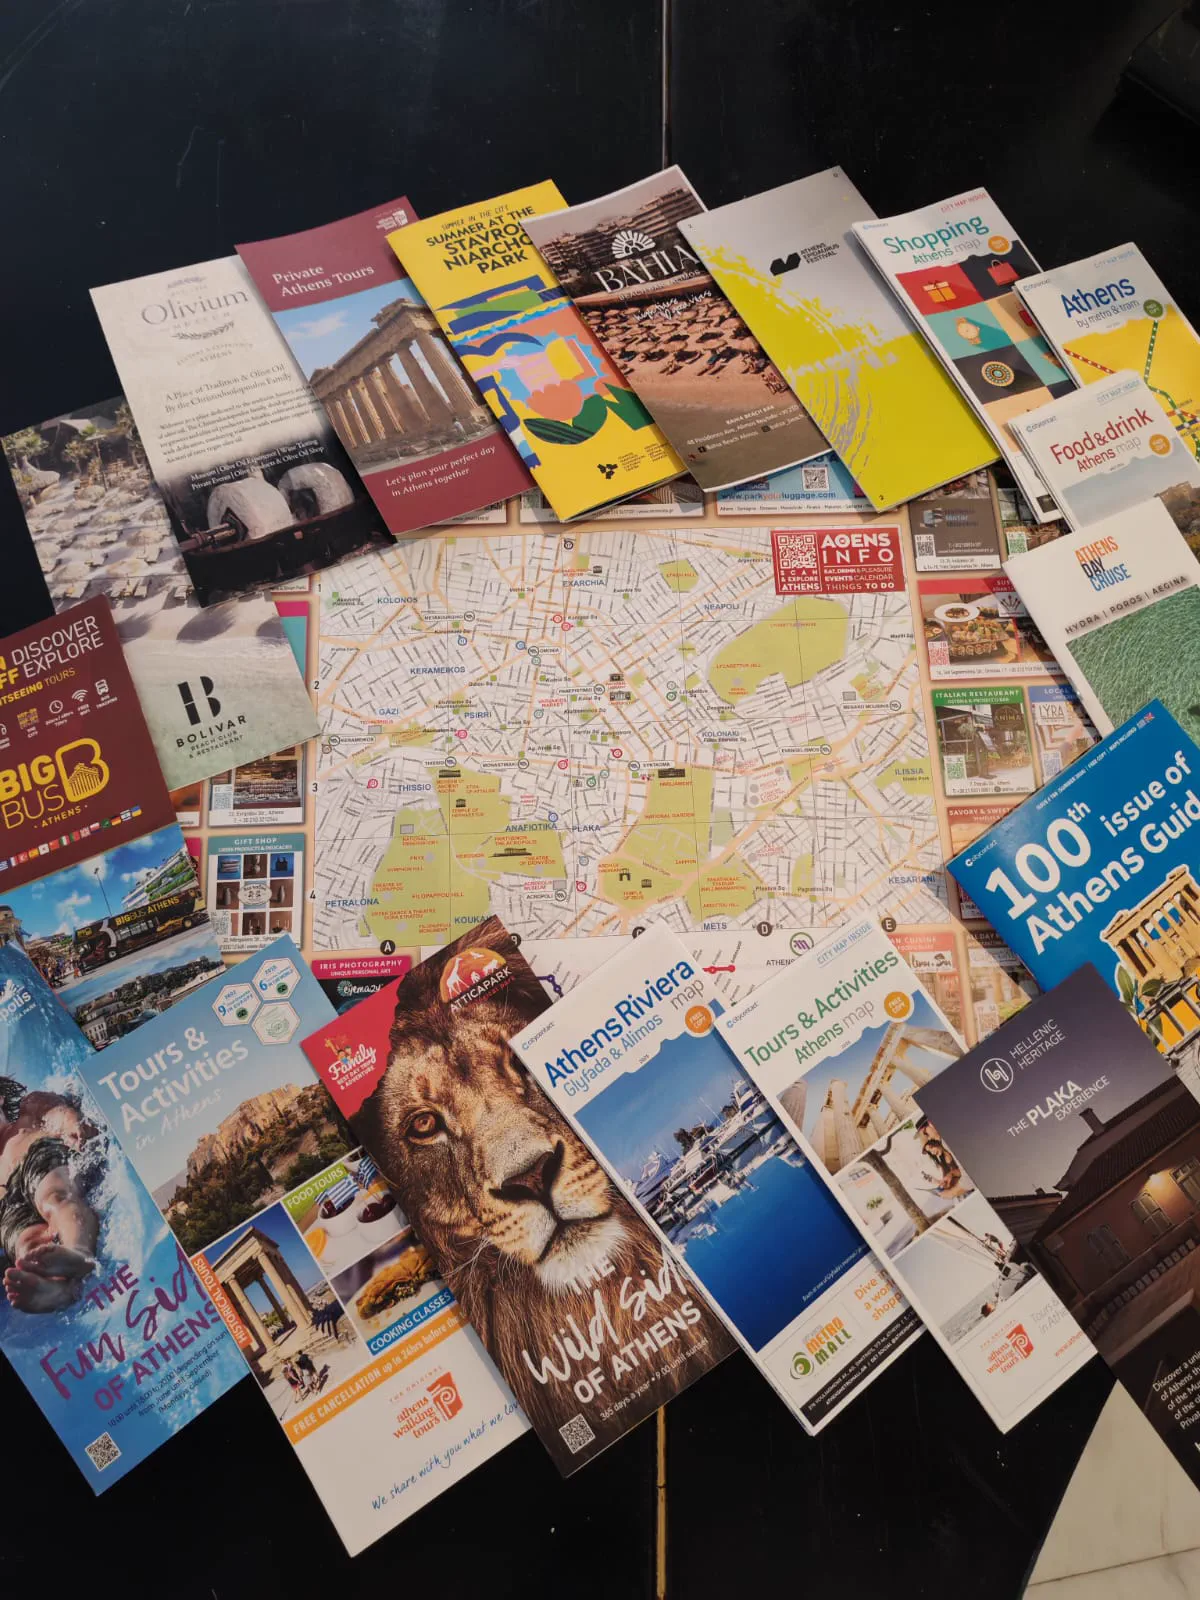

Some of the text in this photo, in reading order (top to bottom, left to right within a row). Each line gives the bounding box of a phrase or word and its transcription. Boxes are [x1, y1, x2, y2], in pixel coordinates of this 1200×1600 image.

[426, 205, 536, 247] SUMMER AT THE
[883, 215, 989, 255] Shopping
[443, 233, 533, 271] NIARCHO
[477, 249, 529, 274] PARK
[912, 238, 983, 265] Athens map
[272, 265, 325, 285] Private
[281, 265, 375, 297] Athens Tours
[594, 244, 701, 294] BAHIA
[141, 290, 249, 326] Olivium
[1060, 278, 1136, 319] Athens
[1075, 299, 1142, 330] by metro tram
[385, 445, 496, 488] Let's plan your perfect day
[1076, 436, 1142, 473] Athens map
[392, 467, 470, 498] in Athens together
[822, 549, 894, 565] INFO
[1074, 535, 1119, 564] ATHENS
[562, 580, 605, 588] EXARCHIA
[788, 575, 819, 583] EXPLORE
[824, 573, 894, 583] EVENTS CALENDAR
[1081, 557, 1106, 579] DAY
[1089, 563, 1131, 592] CRUISE
[377, 596, 418, 604] KOLONOS
[782, 581, 895, 591] ATHENS THINGS TO DO
[704, 603, 740, 611] NEAPOLI
[1064, 575, 1188, 635] HYDRA POROS AEGINA
[11, 615, 99, 666] DISCOVER
[23, 630, 104, 679] EXPLORE
[44, 666, 77, 687] TOURS
[314, 680, 320, 690] 2
[410, 666, 466, 675] KERAMEIKOS
[935, 689, 1020, 698] ITALIAN RESTAURANT
[378, 707, 399, 716] GAZI
[1039, 703, 1064, 717] LYRA
[176, 714, 247, 748] BOLIVAR
[197, 734, 243, 756] RESTAURANT
[218, 730, 238, 741] CLUB
[0, 754, 56, 802] BIG
[312, 782, 318, 793] 3
[1099, 779, 1167, 838] issue
[1165, 750, 1192, 786] of
[1, 783, 65, 829] BUS
[42, 805, 82, 828] ATHENS
[234, 836, 278, 845] GIFT SHOP
[888, 875, 936, 885] KESARIANI
[1026, 846, 1146, 956] Athens
[1139, 789, 1200, 854] Guid
[115, 896, 180, 927] BIG ATHENS
[325, 898, 380, 908] PETRALONA
[704, 923, 727, 931] METS
[384, 941, 391, 952] A
[816, 922, 873, 965] CITY MAP INSIDE
[339, 959, 404, 969] PHOTOGRAPHY
[449, 966, 514, 1013] ATTICAPARK
[670, 978, 705, 1010] map
[743, 950, 900, 1067] Tours & Activities
[793, 1000, 875, 1065] Athens map
[1009, 1019, 1058, 1059] HELLENIC
[97, 1026, 209, 1100] Tours &
[327, 1043, 378, 1082] Family
[563, 1013, 664, 1097] Glyfada & Alimos
[1017, 1029, 1066, 1070] HERITAGE
[120, 1039, 249, 1134] Activities
[1054, 1075, 1111, 1122] EXPERIENCE
[160, 1087, 224, 1137] Athens
[1006, 1079, 1083, 1138] THE PLAKA
[286, 1166, 344, 1210] FOOD TOURS
[85, 1264, 140, 1312] THE
[564, 1258, 617, 1296] THE
[854, 1278, 878, 1300] Dive
[193, 1256, 248, 1344] HISTORICAL TOURS
[863, 1301, 873, 1310] a
[370, 1290, 452, 1352] COOKING CLASSES
[521, 1288, 620, 1385] Wild
[805, 1316, 845, 1355] METRO
[93, 1303, 222, 1412] OF ATHENS
[573, 1299, 702, 1404] OF ATHENS
[813, 1328, 852, 1366] MALL
[986, 1349, 1016, 1375] walking
[987, 1341, 1010, 1363] athens
[39, 1331, 126, 1400] Fun
[292, 1324, 448, 1435] FREE CANCELLATION up before
[599, 1337, 709, 1421] 365 days year until sunset
[1000, 1355, 1020, 1374] tours
[1152, 1362, 1184, 1393] Discover
[1160, 1373, 1194, 1401] of Athens
[1167, 1390, 1189, 1411] of the
[392, 1406, 437, 1439] walking
[396, 1395, 430, 1424] athens
[1173, 1401, 1195, 1421] of the
[412, 1416, 442, 1439] tours
[371, 1412, 504, 1511] We share with you what we
